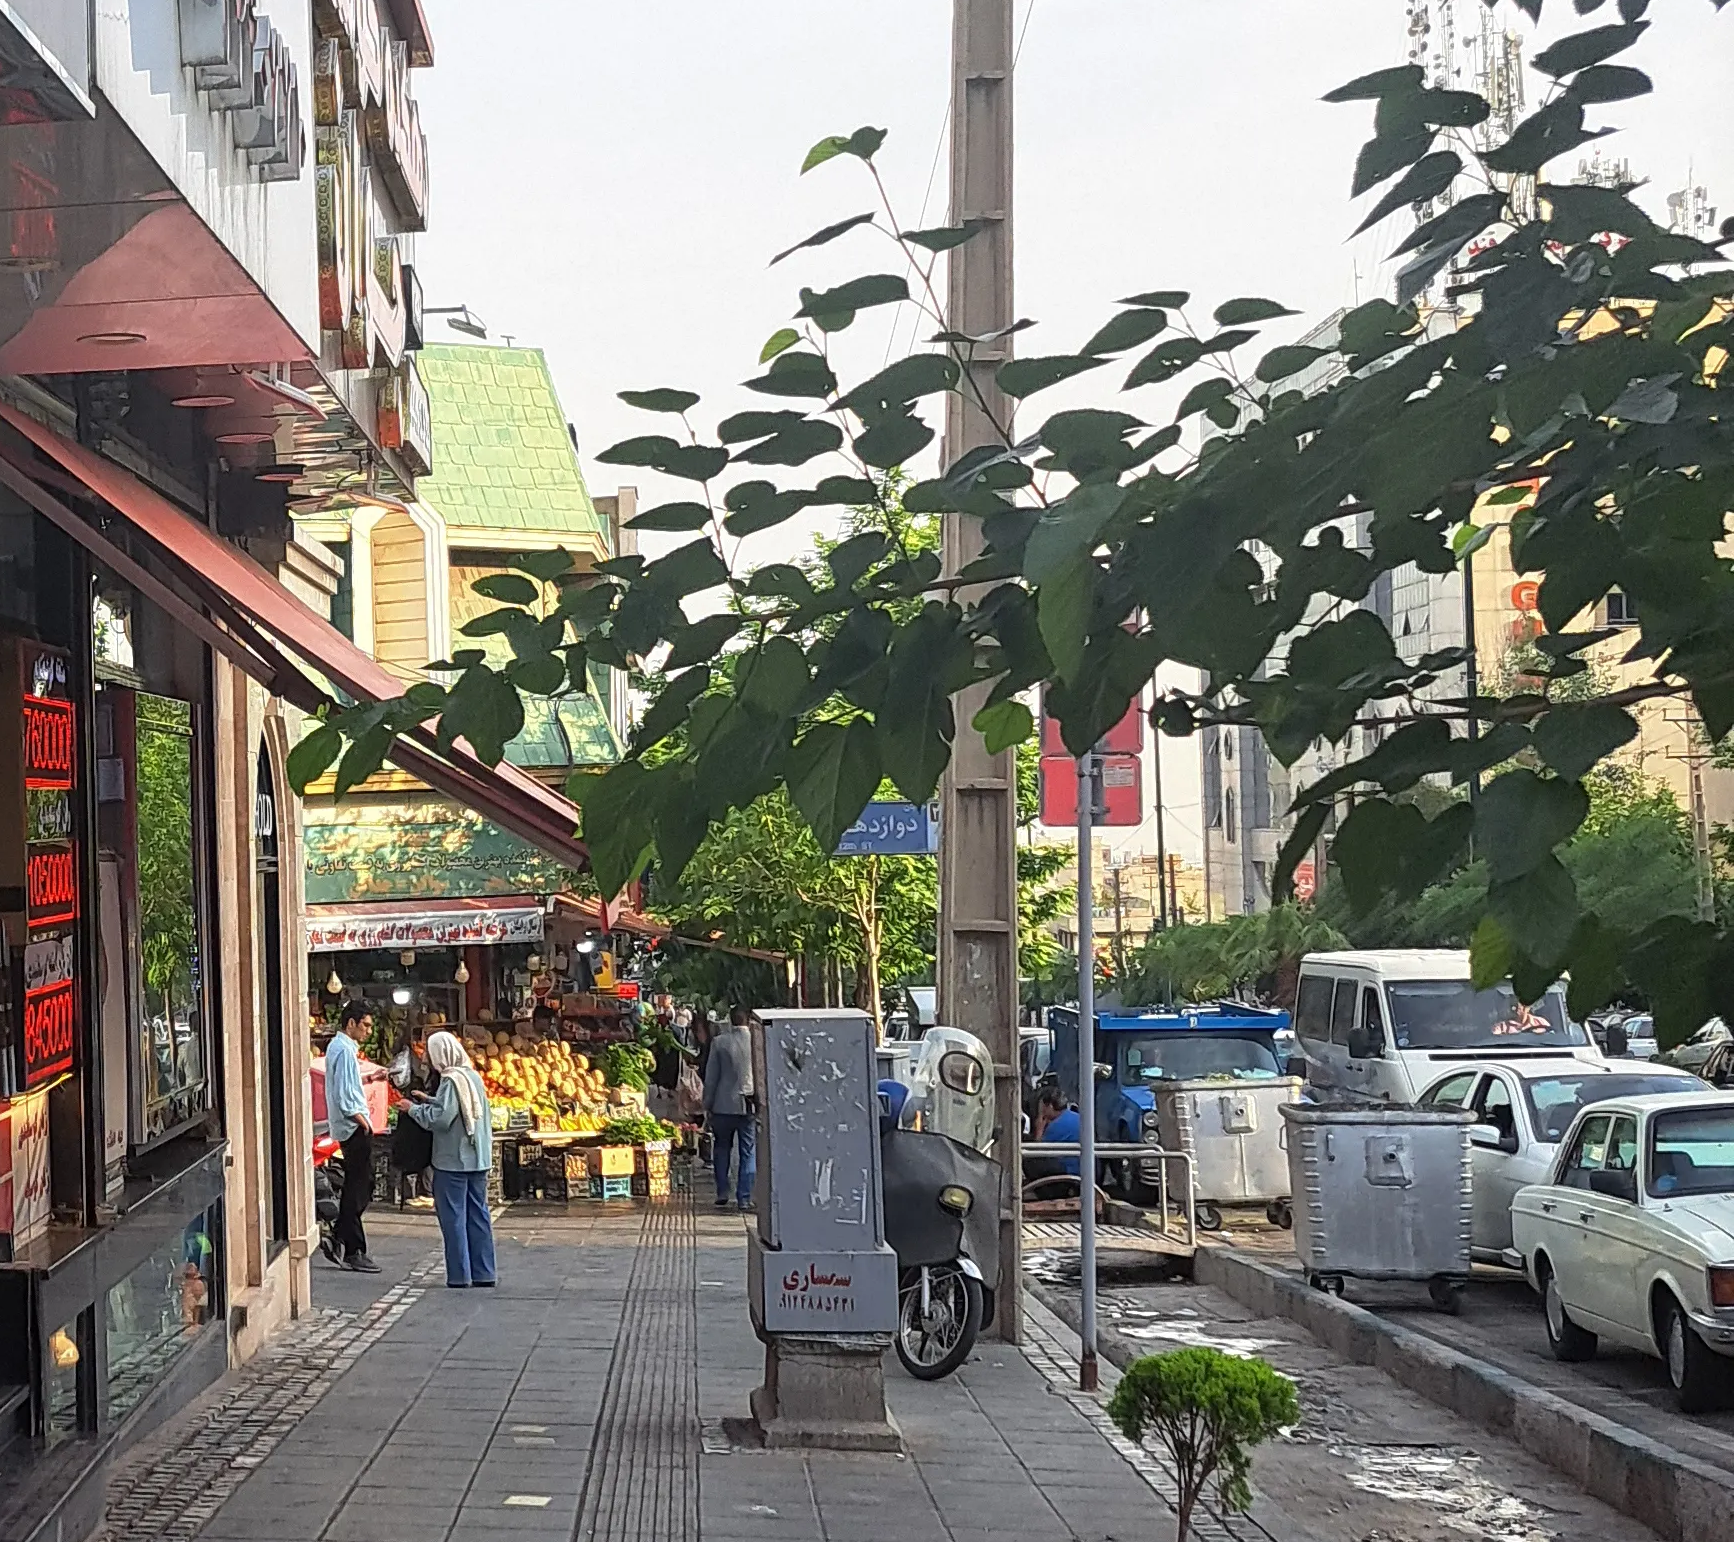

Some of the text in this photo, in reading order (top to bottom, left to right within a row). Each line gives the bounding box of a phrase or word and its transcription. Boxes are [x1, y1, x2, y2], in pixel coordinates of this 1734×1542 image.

[255, 793, 273, 839] OLD
[842, 814, 918, 840] دوازده
[782, 1262, 852, 1292] سمساری
